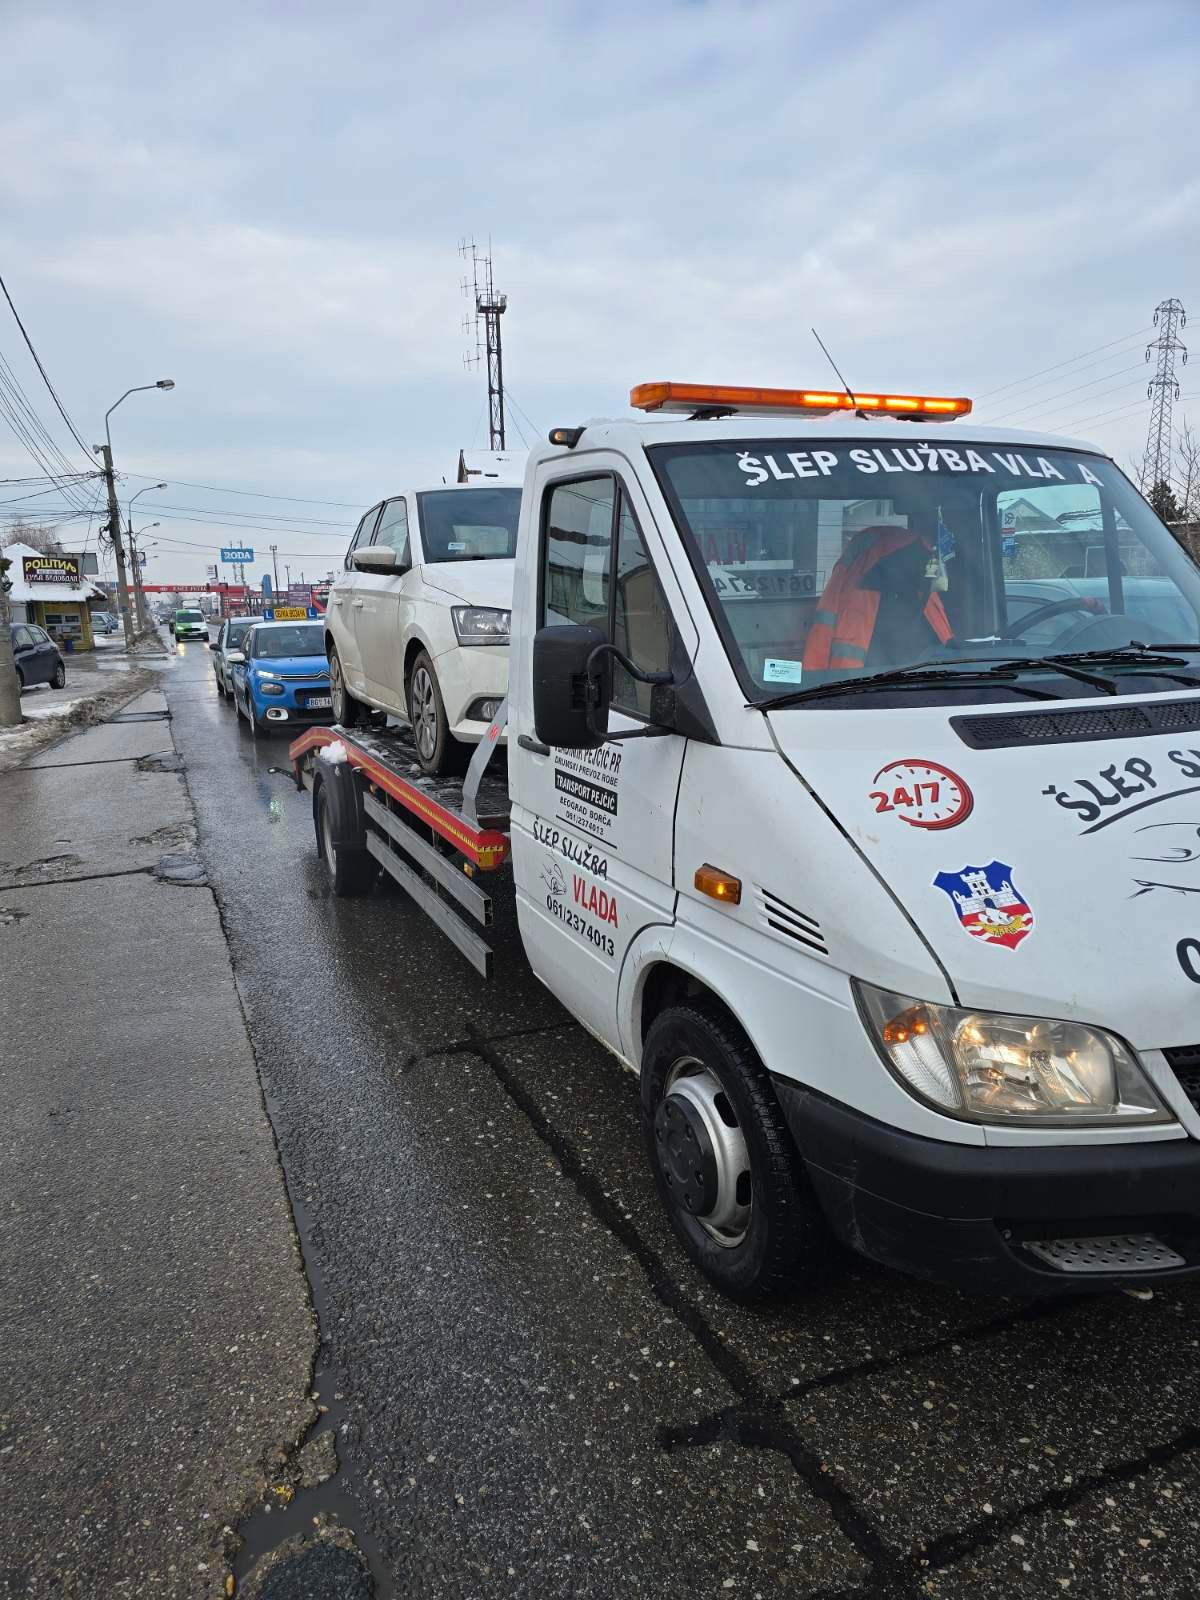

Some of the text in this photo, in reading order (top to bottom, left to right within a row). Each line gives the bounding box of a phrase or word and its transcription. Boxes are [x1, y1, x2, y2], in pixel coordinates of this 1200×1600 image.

[736, 451, 838, 486] ŠLEP
[850, 442, 996, 474] SLUŽBA
[25, 558, 77, 573] РОШТИЉ
[223, 550, 251, 560] RODA
[265, 611, 273, 619] L
[308, 609, 315, 617] L
[578, 764, 601, 781] PREVOZ
[602, 773, 619, 787] ROBE
[610, 752, 622, 774] PR
[556, 774, 591, 800] TRANSPORT
[1041, 757, 1158, 822] ŠLEP
[560, 796, 611, 828] BEOGRAD BORČA
[533, 814, 608, 881] ŠLEP SLUŽBA
[573, 874, 619, 929] VLADA
[546, 894, 615, 957] 061/2374013
